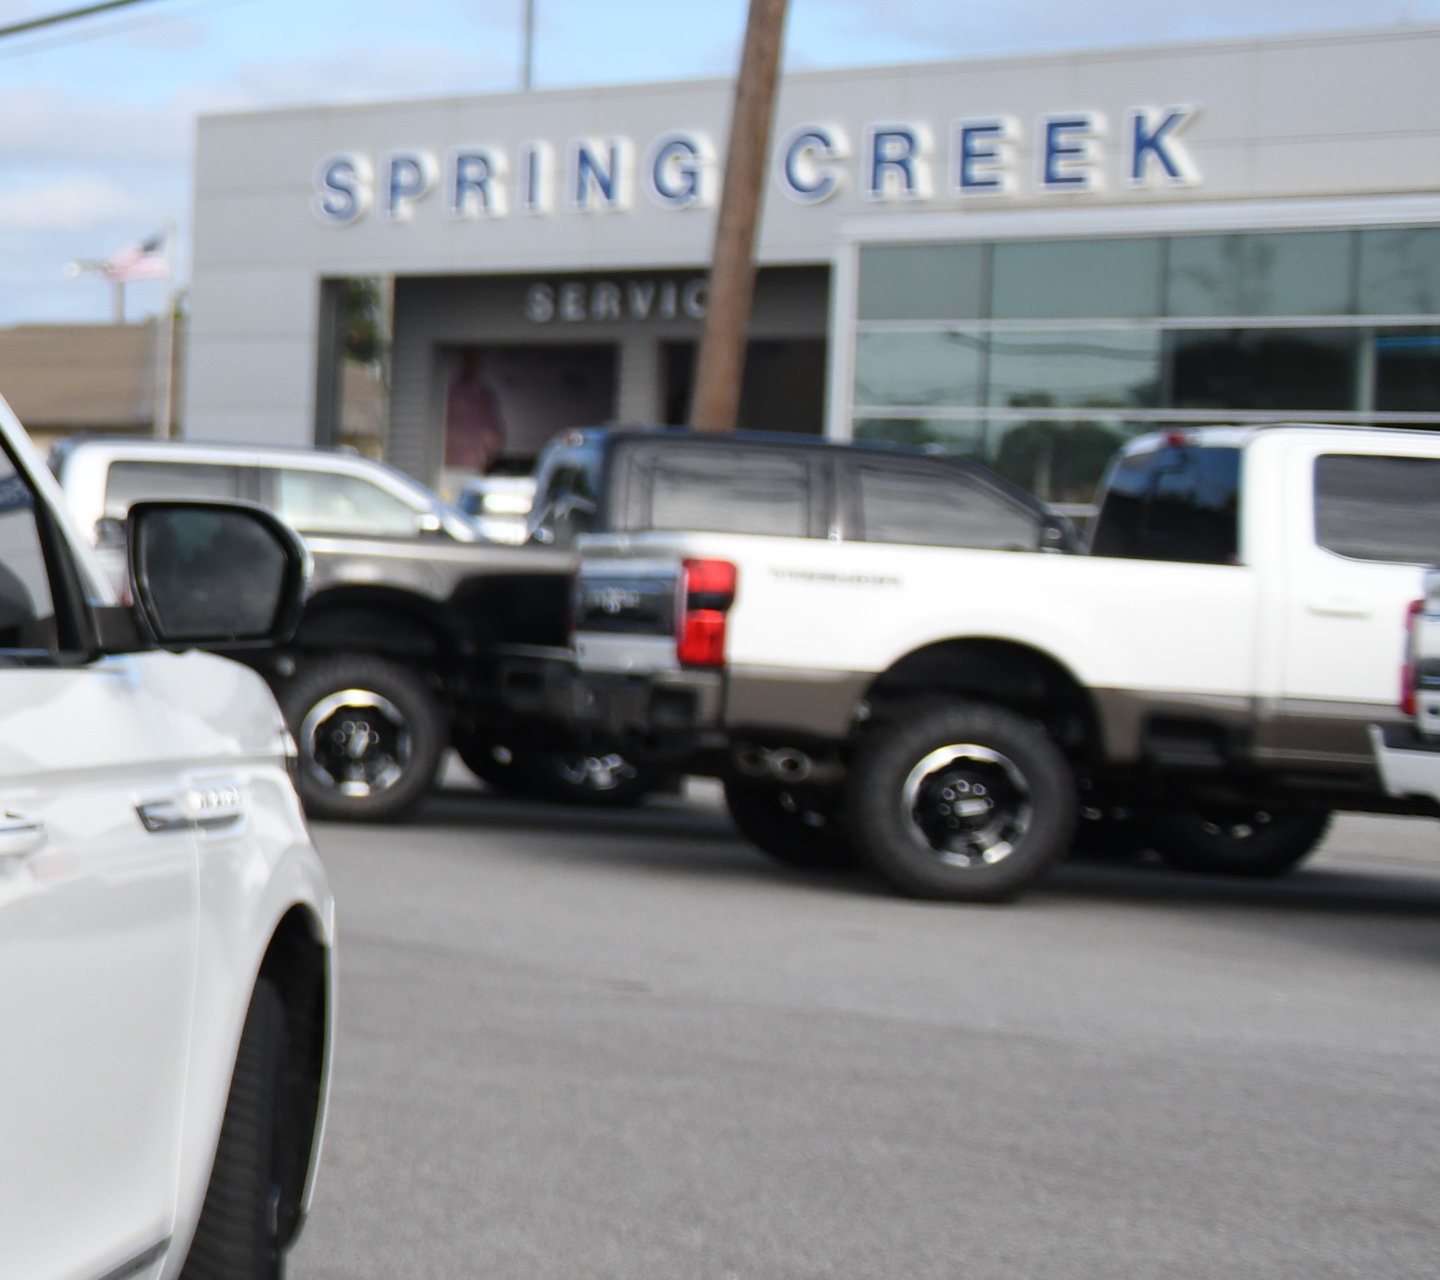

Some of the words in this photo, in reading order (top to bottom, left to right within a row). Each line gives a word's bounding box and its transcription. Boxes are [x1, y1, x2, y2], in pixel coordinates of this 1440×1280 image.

[314, 131, 715, 224] SPRING
[781, 104, 1203, 204] CREEK
[528, 278, 716, 322] SERVIC
